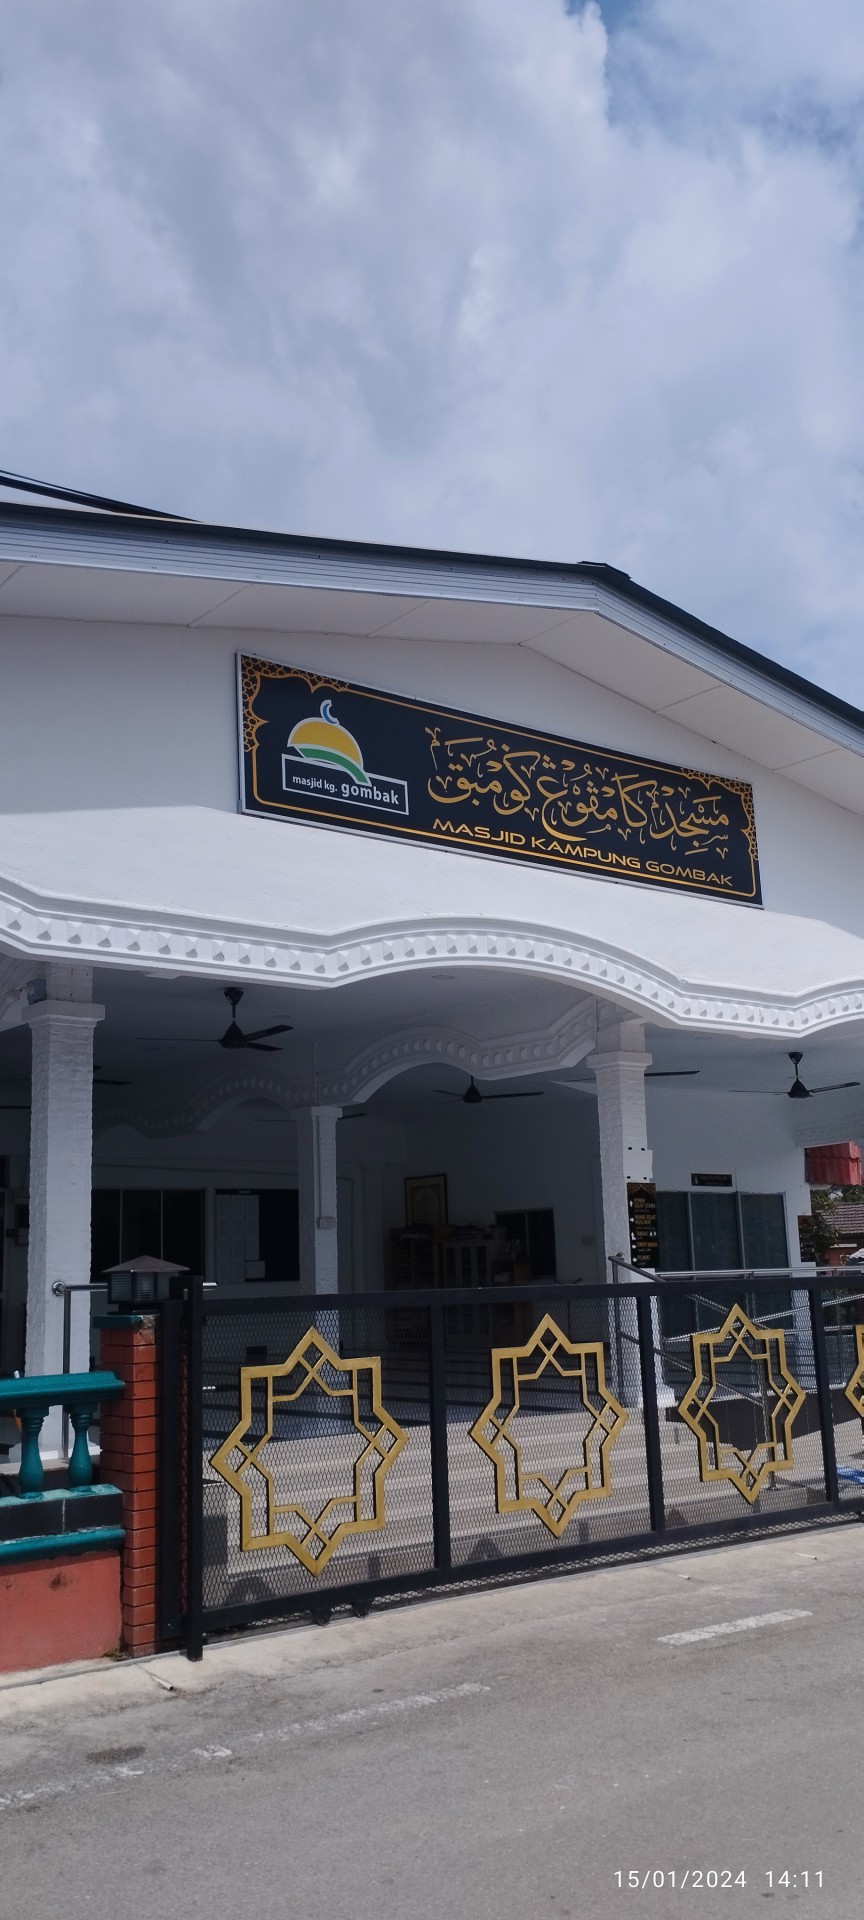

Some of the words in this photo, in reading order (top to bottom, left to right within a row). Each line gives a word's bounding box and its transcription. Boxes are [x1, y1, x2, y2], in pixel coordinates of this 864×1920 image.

[292, 775, 323, 790] masjid
[324, 780, 338, 794] kg.
[341, 783, 400, 805] gombak
[432, 818, 526, 846] MASJID
[531, 836, 641, 869] KAMPUNG
[645, 860, 733, 887] GOMBAK
